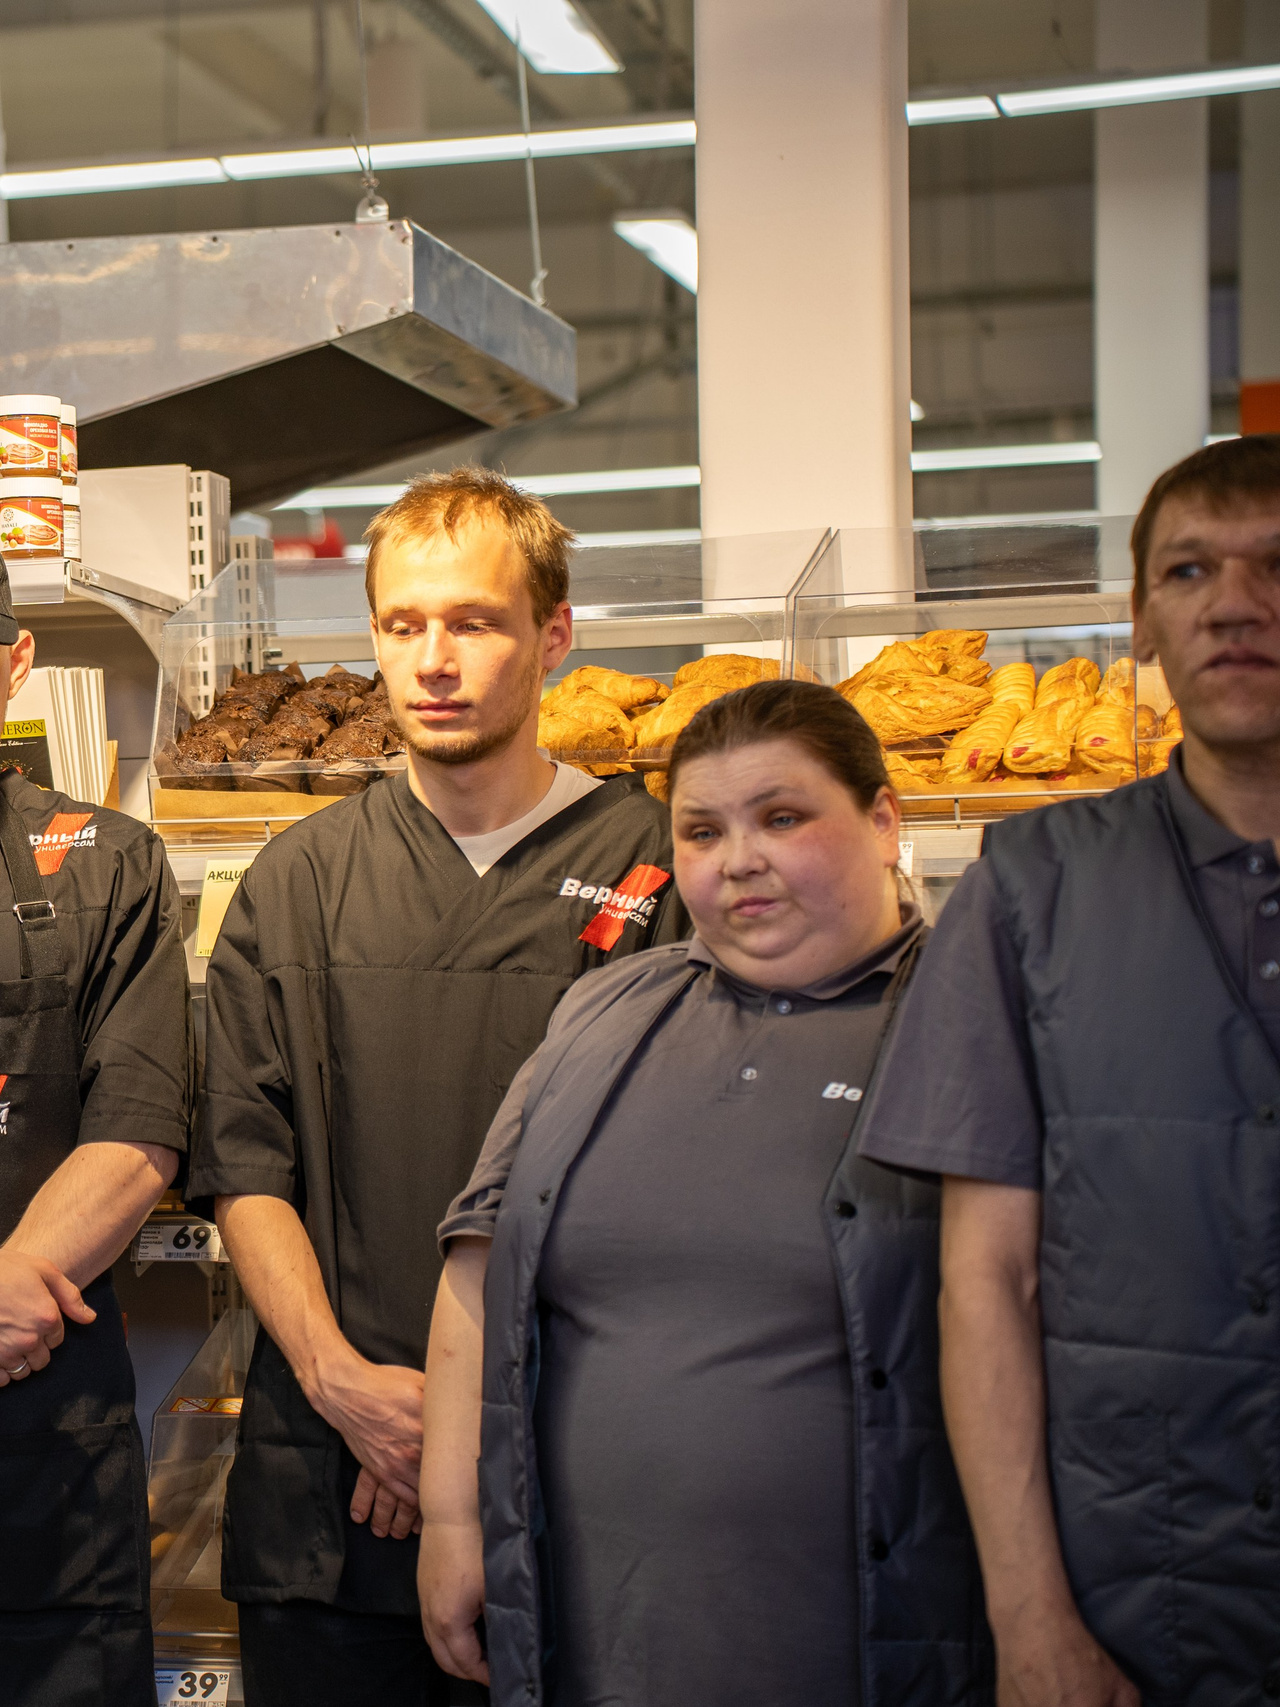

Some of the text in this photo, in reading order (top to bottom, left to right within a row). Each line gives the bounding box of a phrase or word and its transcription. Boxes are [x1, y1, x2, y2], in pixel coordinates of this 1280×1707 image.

[3, 722, 44, 735] ERON
[28, 825, 98, 847] рный
[35, 839, 95, 853] универсам
[207, 870, 243, 882] АКЦИ
[560, 877, 658, 917] Верный
[172, 1225, 211, 1250] 69
[178, 1671, 218, 1699] 39
